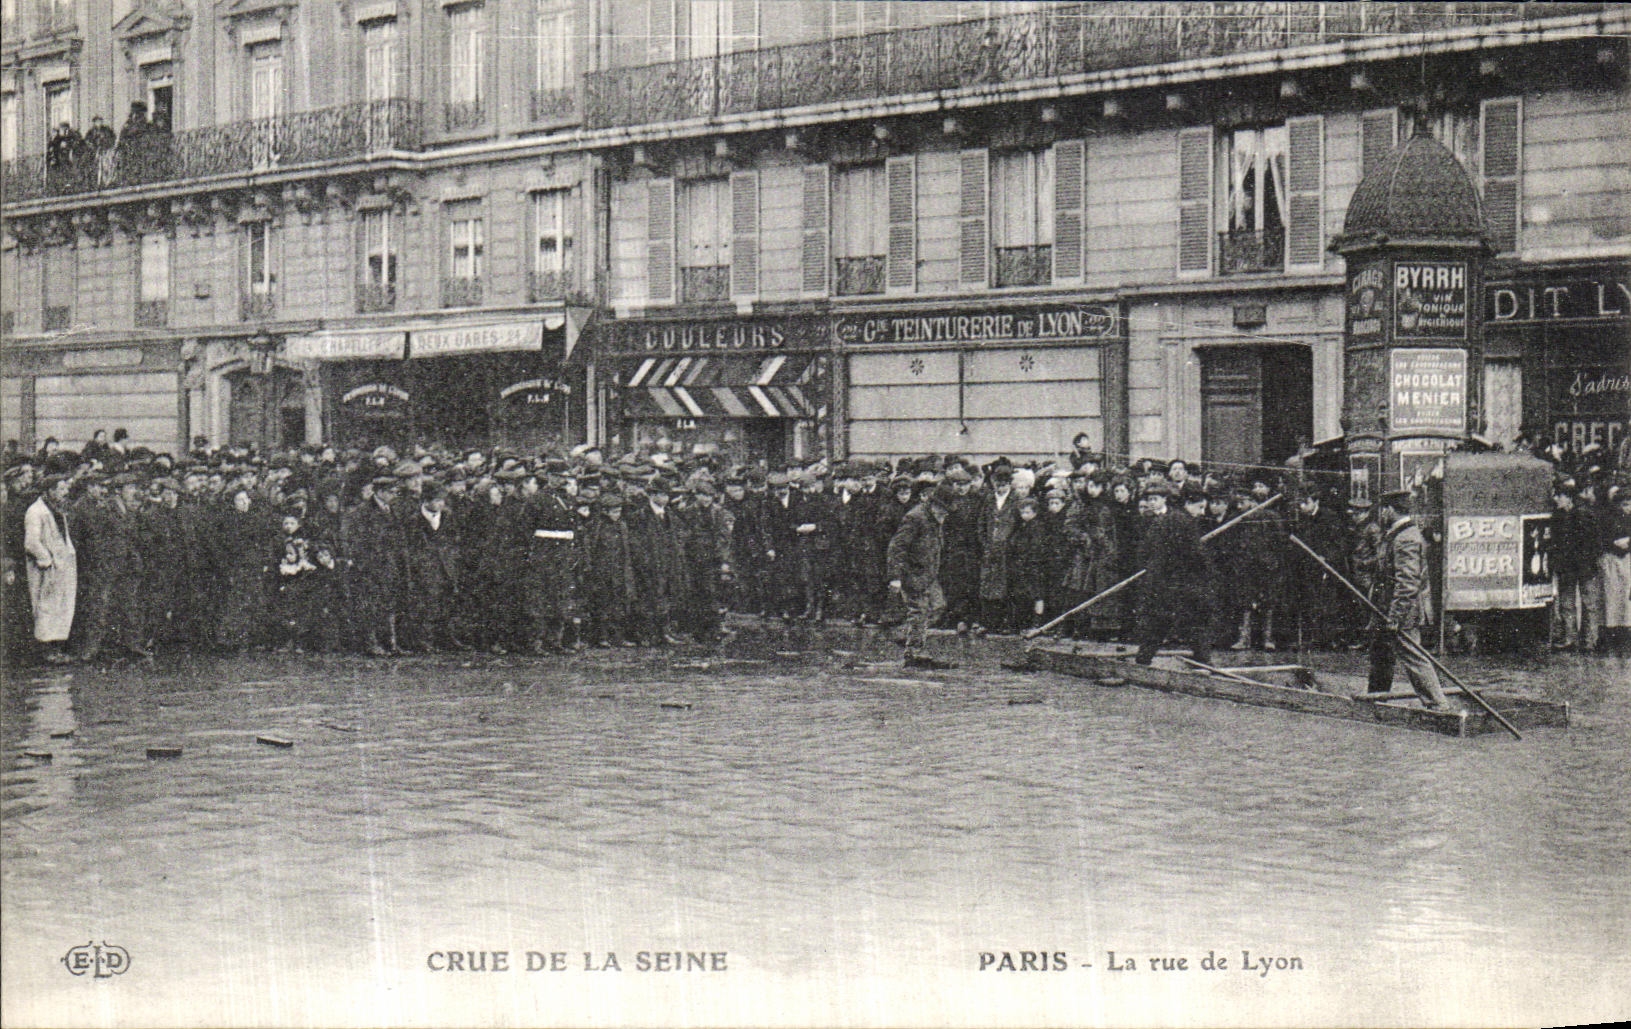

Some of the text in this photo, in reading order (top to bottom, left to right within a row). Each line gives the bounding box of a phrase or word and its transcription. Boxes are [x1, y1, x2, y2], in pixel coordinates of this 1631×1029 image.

[1396, 266, 1464, 290] BYRRH
[1418, 303, 1465, 314] TONIQUE
[1494, 286, 1569, 320] DIT
[645, 324, 785, 350] COULEURS
[891, 314, 1014, 342] TEINTURERIE
[1038, 311, 1083, 337] LYON
[1394, 373, 1464, 389] CHOCOLAT
[1397, 391, 1461, 406] MENIER
[1454, 518, 1515, 541] BEC
[1449, 553, 1515, 576] AUER
